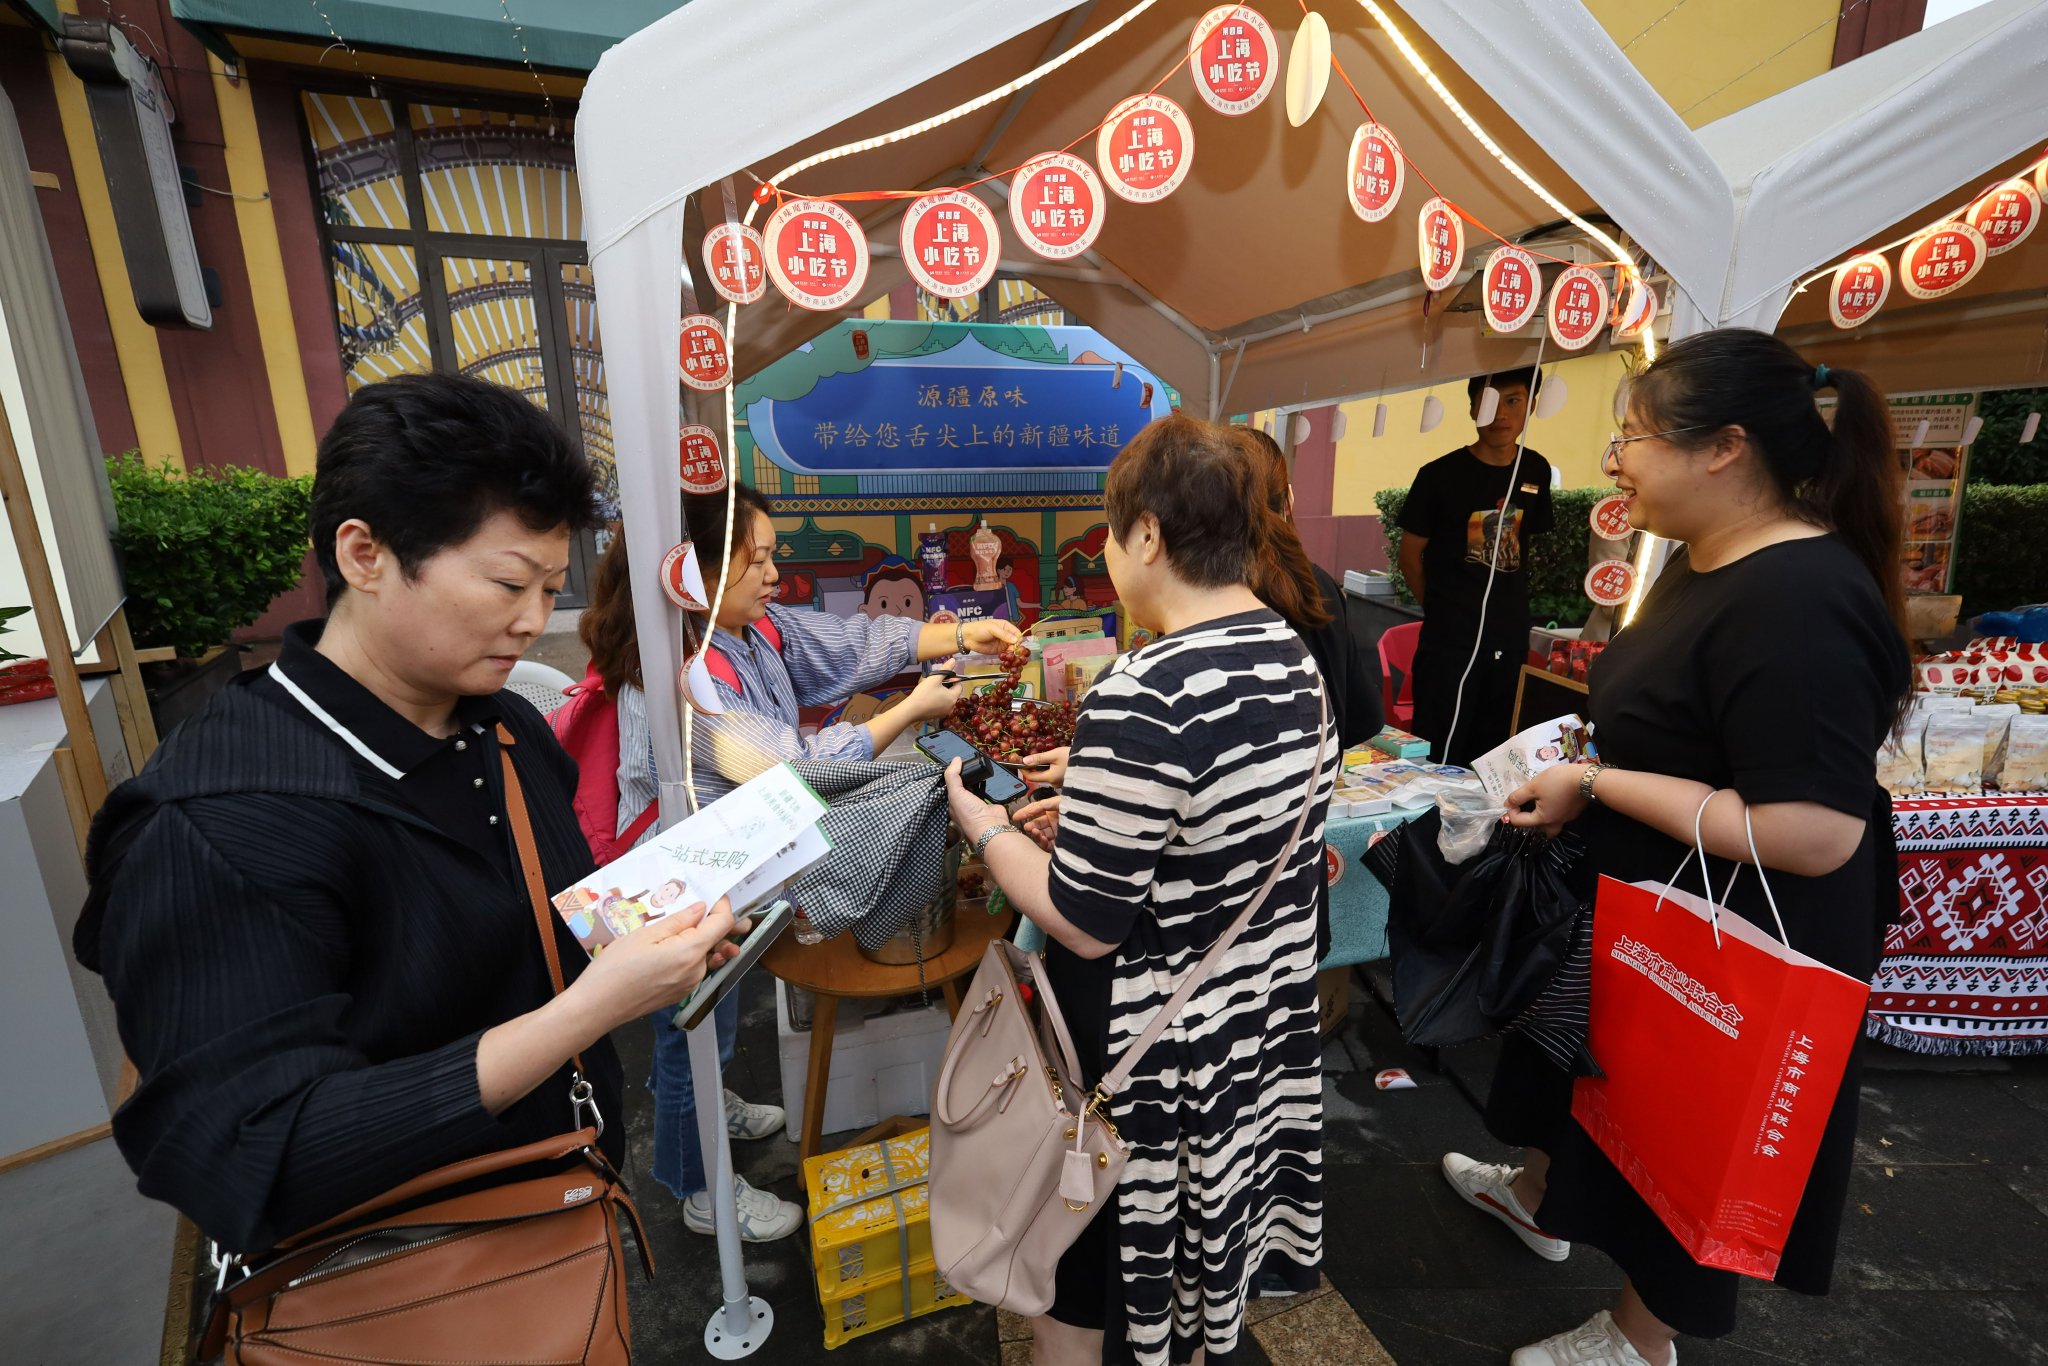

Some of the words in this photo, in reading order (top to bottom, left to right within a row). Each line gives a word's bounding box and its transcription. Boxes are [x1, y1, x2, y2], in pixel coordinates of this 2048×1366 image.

[1217, 38, 1251, 60] 上海
[1209, 61, 1261, 84] 小吃节
[1127, 127, 1163, 150] 上海
[1119, 149, 1174, 173] 小吃节
[1362, 152, 1385, 175] 上海
[1356, 171, 1390, 196] 小吃节
[1039, 185, 1075, 205] 上海
[937, 211, 961, 220] 第四届
[1031, 208, 1085, 228] 小吃节
[1990, 202, 2020, 217] 上海
[803, 220, 828, 230] 第四届
[932, 223, 970, 243] 上海
[1979, 219, 2023, 235] 小吃节
[797, 232, 837, 254] 上海
[1431, 225, 1449, 246] 上海
[923, 246, 980, 267] 小吃节
[1928, 244, 1960, 262] 上海
[788, 255, 848, 278] 小吃节
[1917, 260, 1967, 279] 小吃节
[1498, 271, 1521, 290] 上海
[1851, 275, 1875, 290] 上海
[1491, 289, 1525, 309] 小吃节
[1566, 291, 1590, 308] 上海
[1841, 292, 1876, 307] 小吃节
[1558, 308, 1593, 326] 小吃节
[690, 338, 717, 354] 上海
[686, 353, 726, 371] 小吃节
[917, 385, 1028, 408] 源疆原味
[813, 422, 1124, 451] 带给您舌尖上的新疆味道
[686, 446, 712, 461] 上海
[682, 460, 721, 477] 小吃节
[926, 546, 942, 554] NFC
[957, 606, 983, 617] NFC
[659, 843, 749, 871] 一站式采购
[1614, 935, 1744, 1027] 上海市商业联合会
[1611, 949, 1648, 976] SHANGHAI
[1648, 971, 1688, 1007] COMMERCIAL
[1687, 1001, 1739, 1040] ASSOCIATION
[1761, 1034, 1813, 1158] 上海市商业联合会
